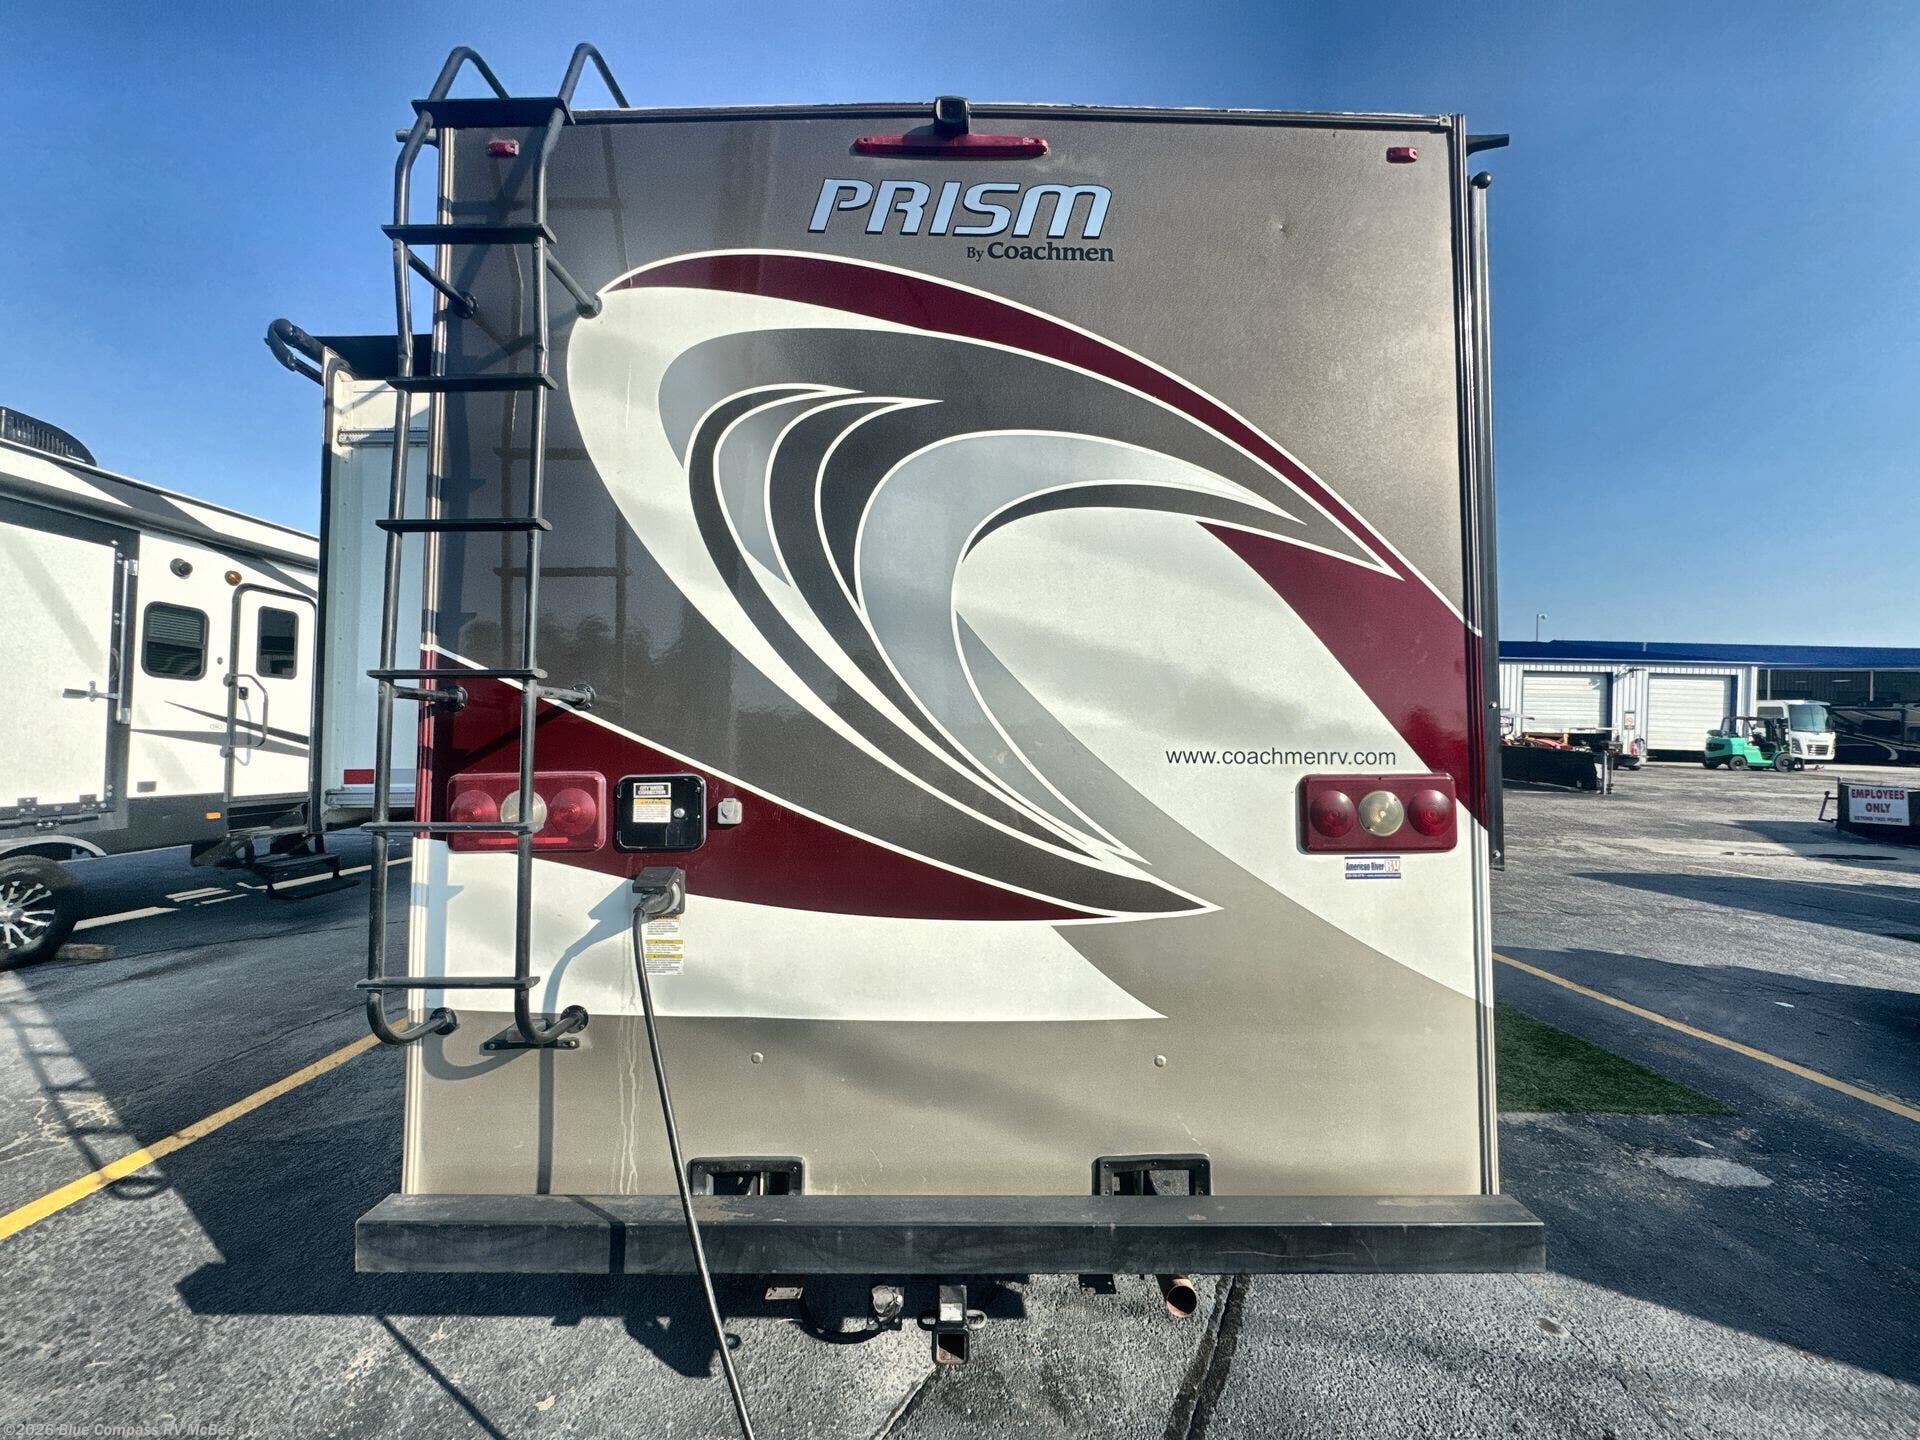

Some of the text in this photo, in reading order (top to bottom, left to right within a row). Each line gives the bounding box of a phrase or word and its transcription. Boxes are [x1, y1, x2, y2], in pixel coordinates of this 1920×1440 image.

[807, 178, 1113, 239] PRISM
[966, 242, 1115, 262] By Coachmen
[1165, 747, 1397, 766] www.coachmenrv.com
[1851, 789, 1905, 800] EMPLOYEES
[1865, 802, 1891, 813] ONLY
[1346, 862, 1371, 871] American
[1371, 861, 1385, 871] River
